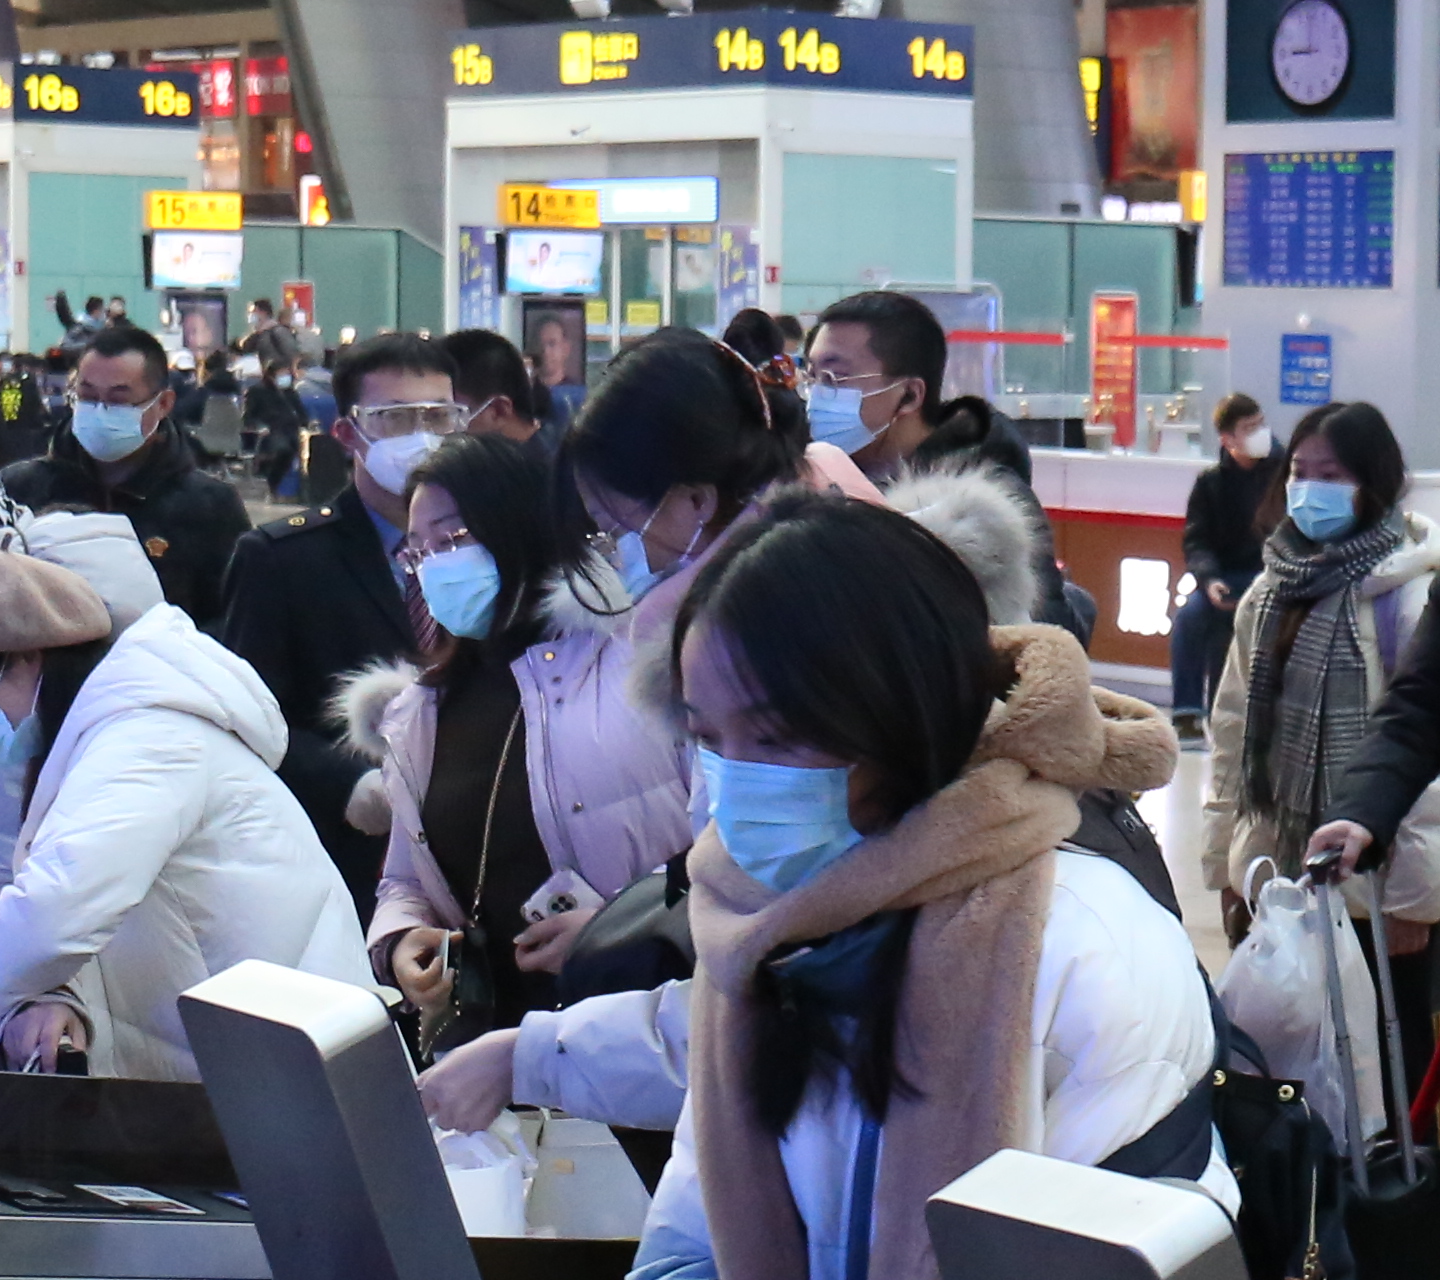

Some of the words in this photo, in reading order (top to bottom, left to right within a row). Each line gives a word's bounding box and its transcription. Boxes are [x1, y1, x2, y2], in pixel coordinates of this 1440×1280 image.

[451, 44, 493, 86] 15B
[716, 29, 764, 72] 14B
[780, 29, 840, 74] 14B
[908, 37, 965, 81] 14B
[24, 75, 79, 112] 16B
[140, 81, 191, 117] 16B
[157, 196, 186, 225] 15
[510, 191, 542, 222] 14
